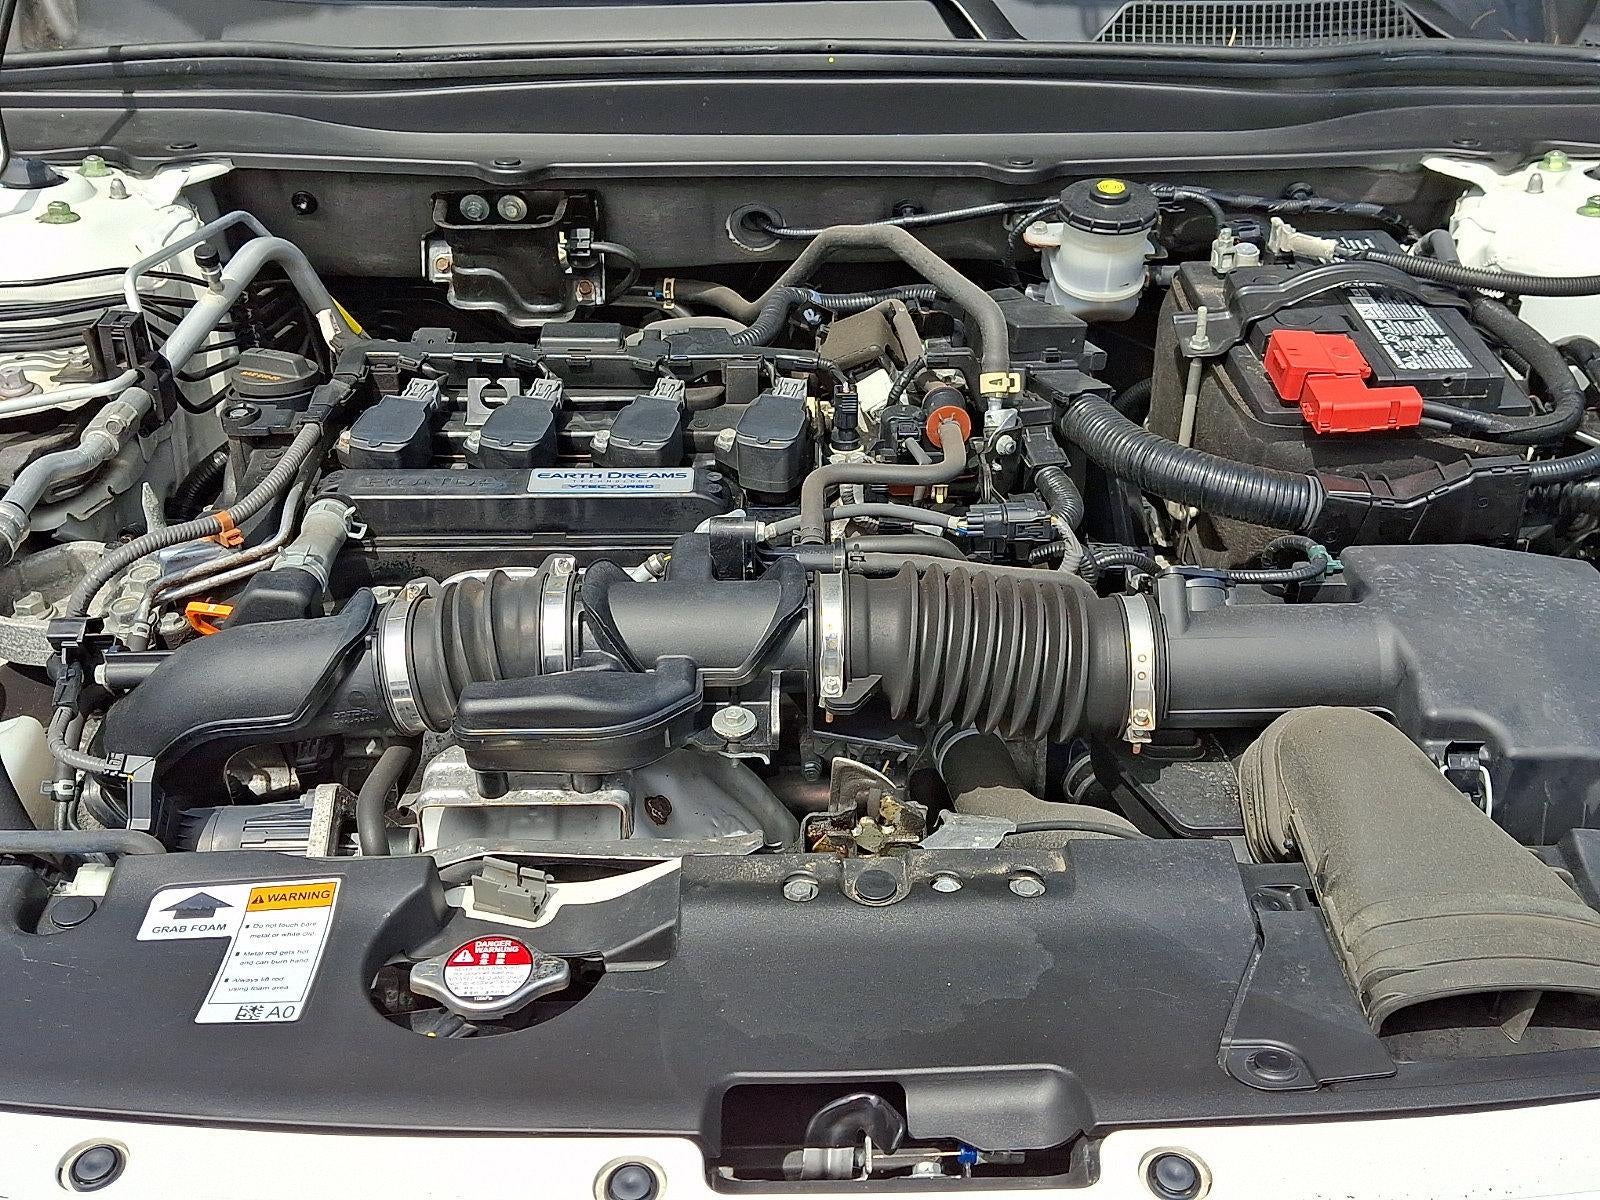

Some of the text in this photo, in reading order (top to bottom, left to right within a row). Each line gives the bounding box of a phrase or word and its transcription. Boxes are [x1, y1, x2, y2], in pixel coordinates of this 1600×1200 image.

[608, 471, 688, 479] DREAMS
[267, 891, 331, 903] WARNING
[151, 923, 227, 934] GRAB FOAM
